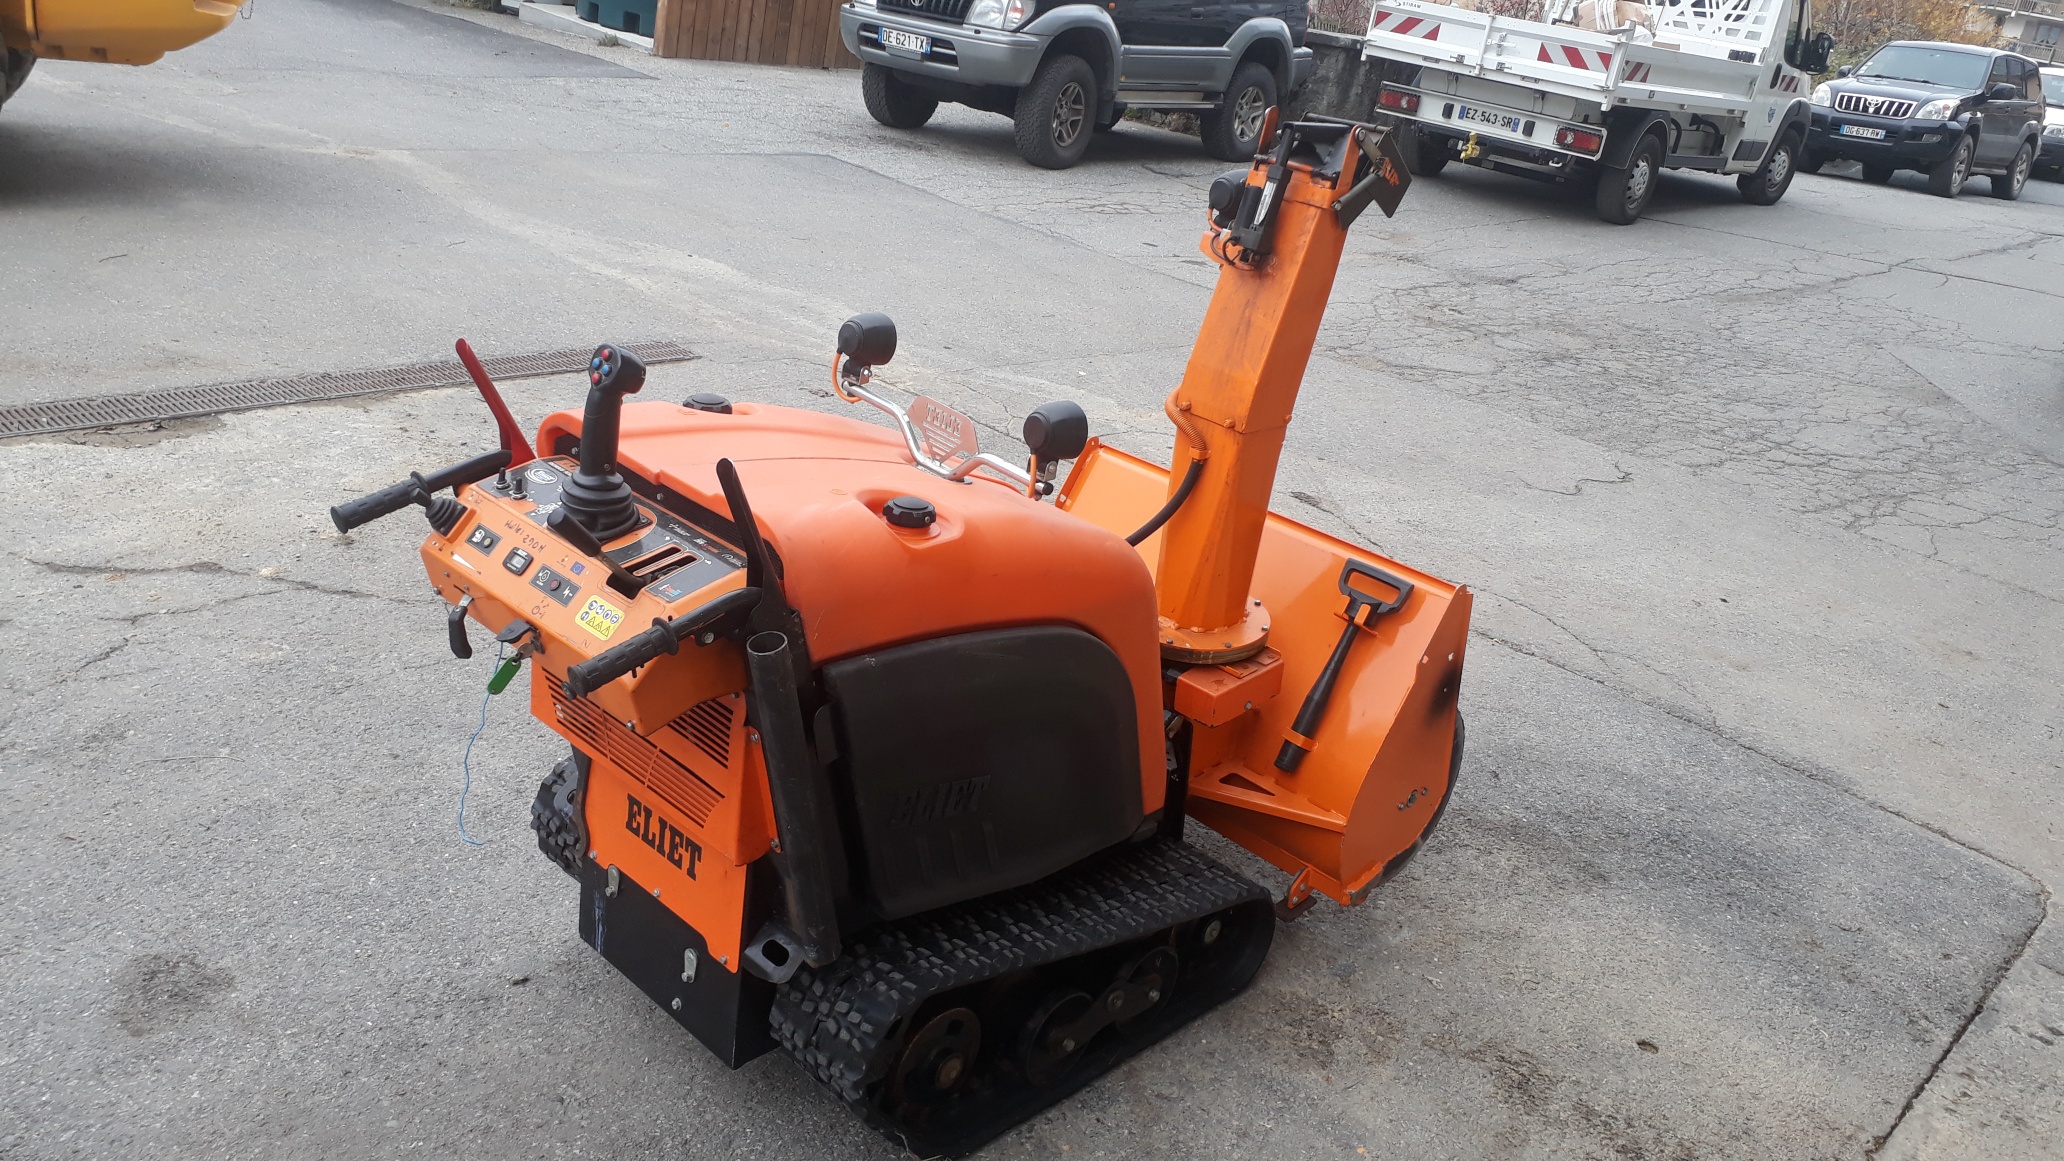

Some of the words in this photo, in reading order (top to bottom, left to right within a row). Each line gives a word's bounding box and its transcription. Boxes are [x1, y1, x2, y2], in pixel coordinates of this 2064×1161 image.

[882, 29, 925, 51] DE-621-TX
[1465, 107, 1513, 128] EZ-543-SR
[625, 792, 703, 882] ELIET
